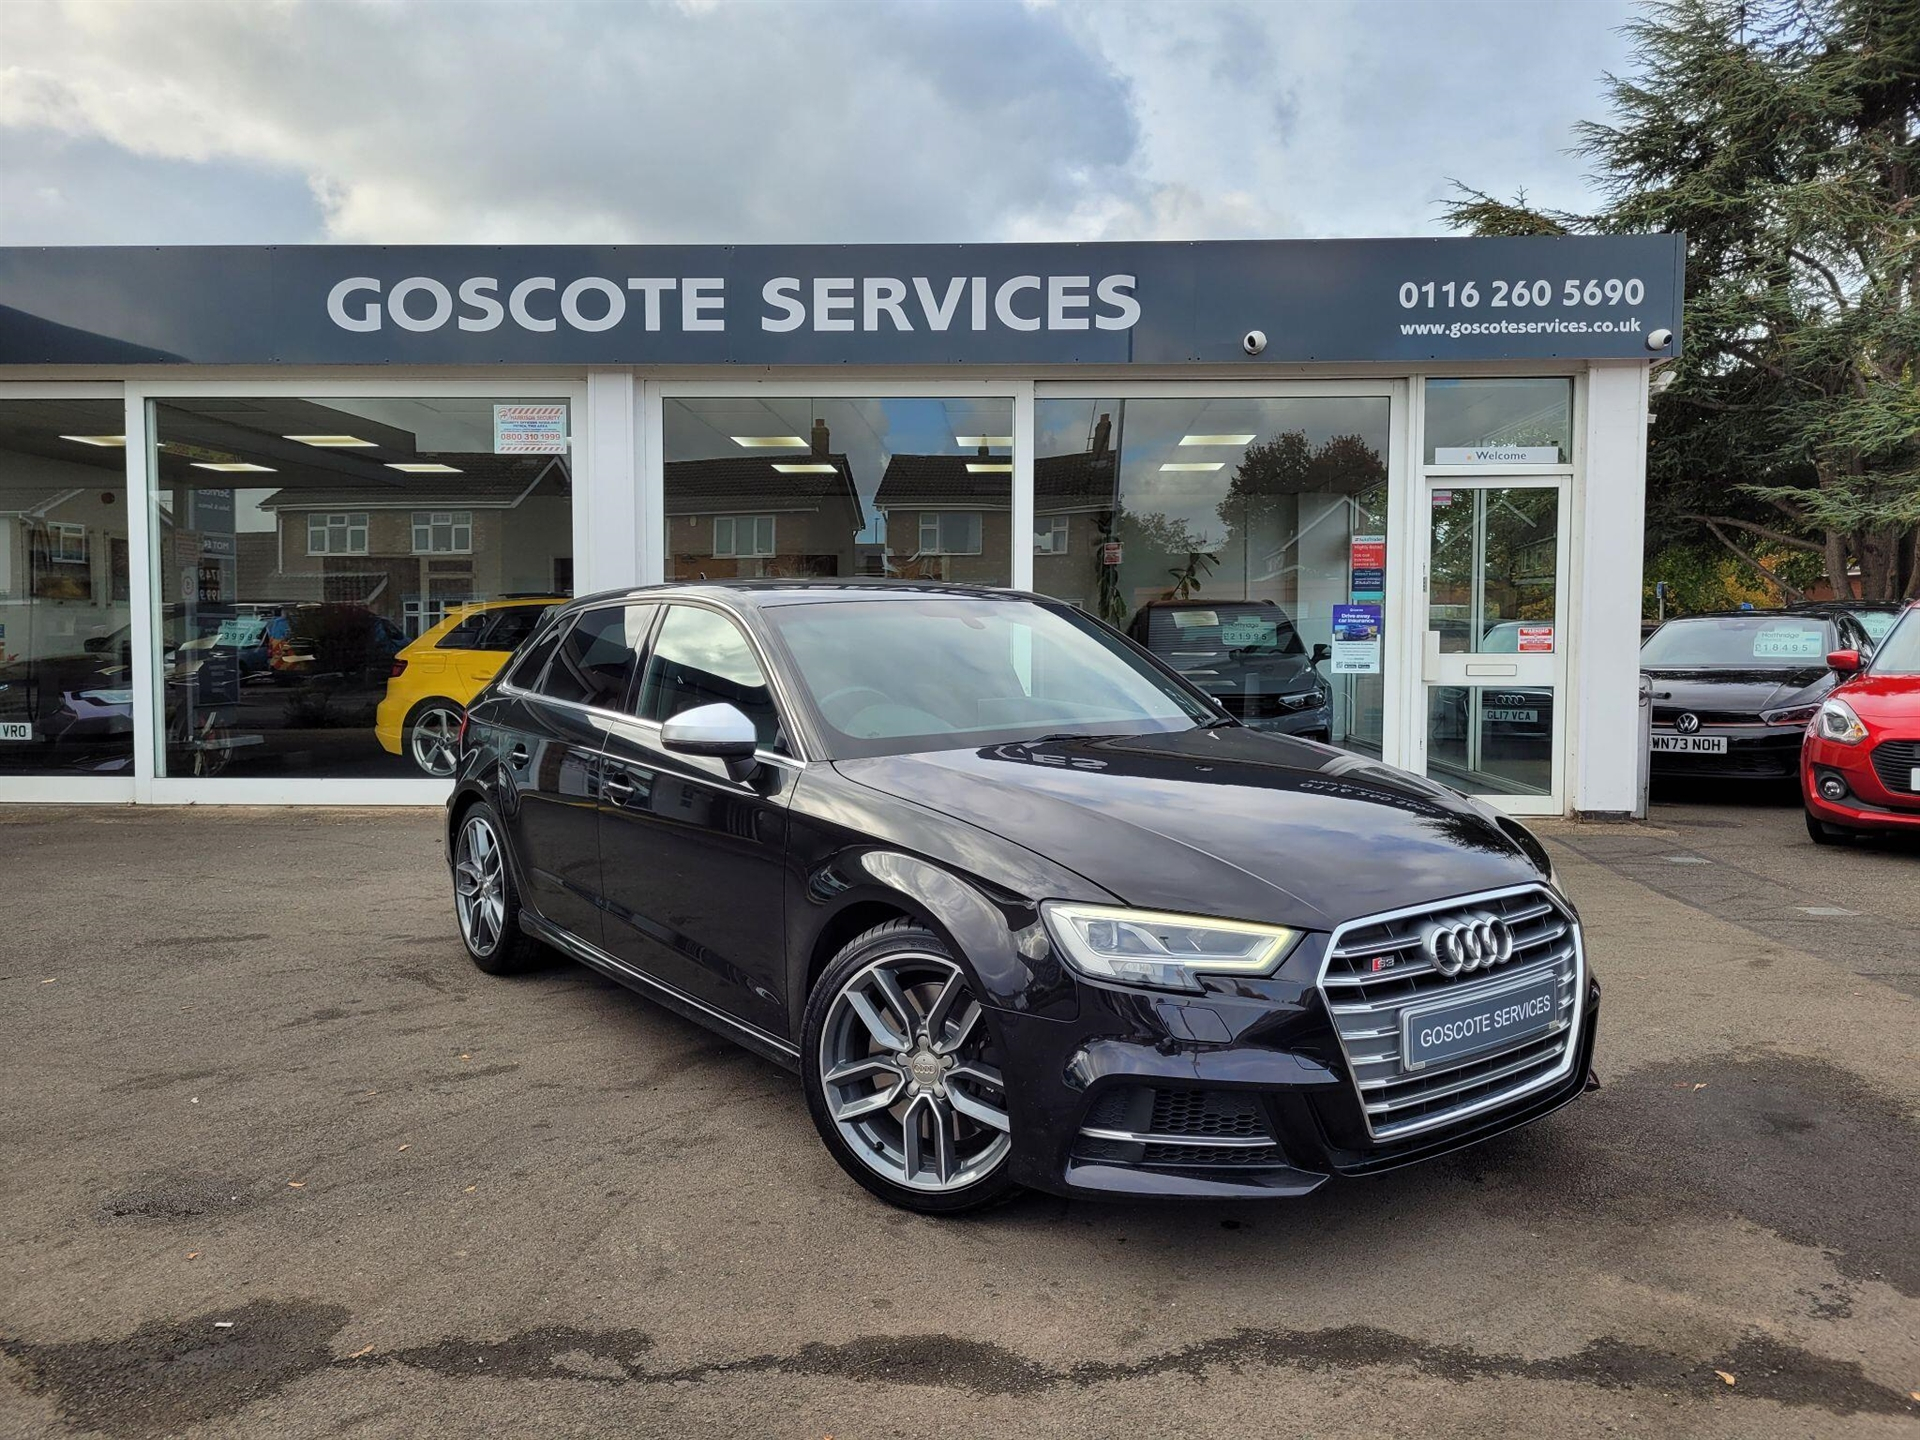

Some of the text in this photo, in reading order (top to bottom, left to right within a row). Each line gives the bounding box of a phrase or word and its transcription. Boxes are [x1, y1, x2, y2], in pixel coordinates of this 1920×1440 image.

[1399, 278, 1645, 309] 0116 260 5690
[326, 274, 1141, 333] GOSCOTE SERVICES
[1400, 317, 1641, 339] www.goscoteservices.co.uk
[1476, 451, 1527, 460] Welcome
[1487, 710, 1531, 721] GL17 VCA
[3, 725, 26, 737] VRO
[1652, 737, 1721, 751] WN73 NOH
[1420, 994, 1551, 1047] GOSCOTE SERVICES
